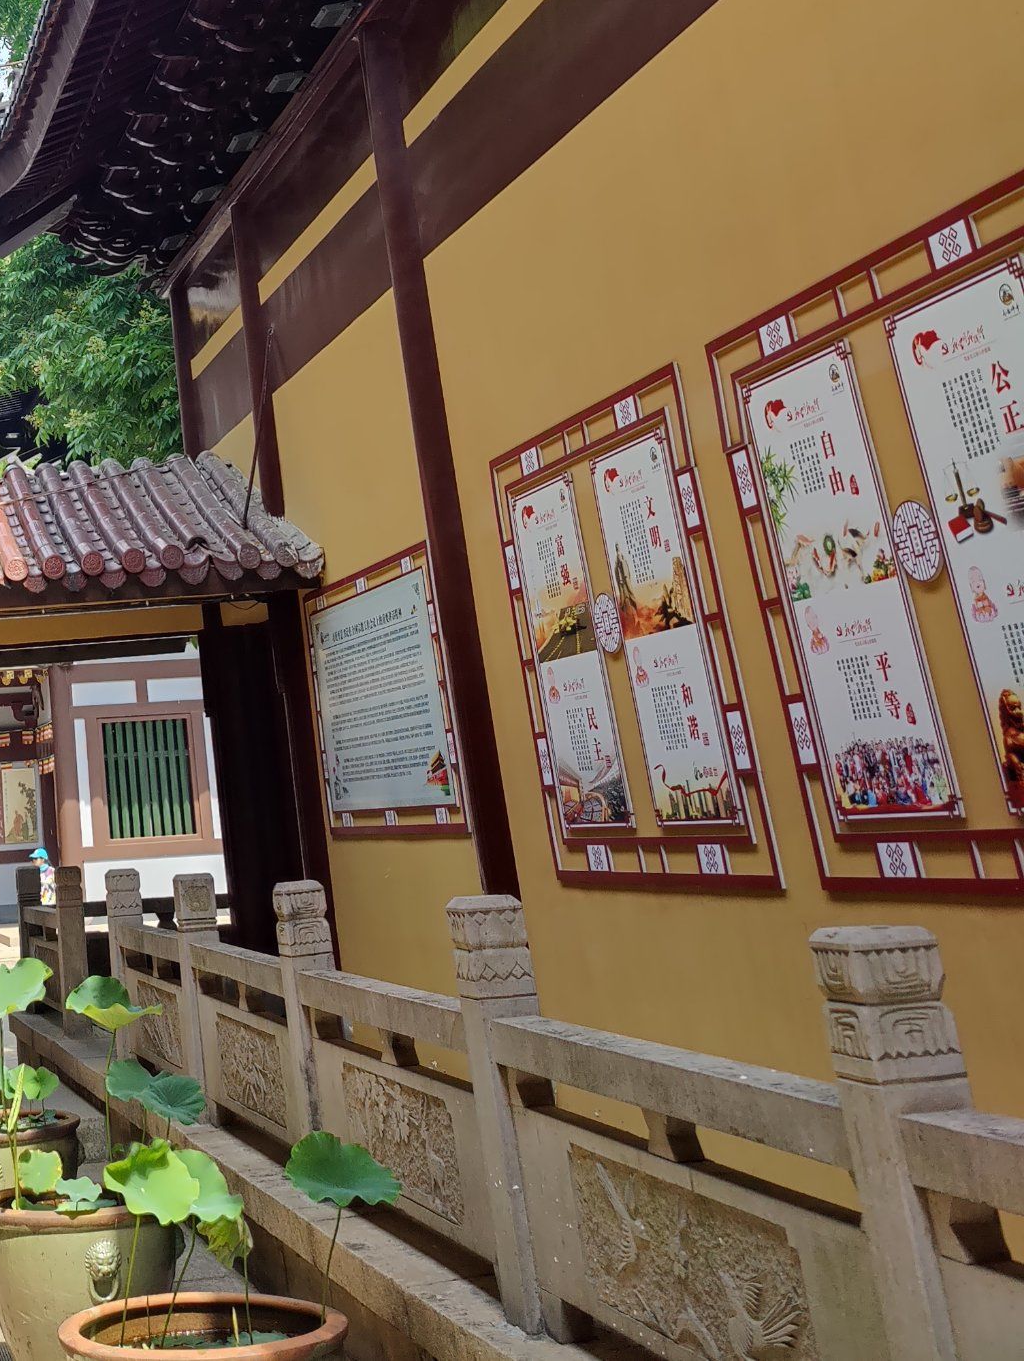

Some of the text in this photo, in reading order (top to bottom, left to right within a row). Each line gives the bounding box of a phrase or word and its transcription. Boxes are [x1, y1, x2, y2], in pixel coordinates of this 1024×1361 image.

[991, 360, 1024, 434] 公正
[820, 430, 845, 495] 自由
[643, 496, 662, 549] 文明
[555, 534, 571, 586] 富强
[681, 683, 700, 740] 和谐
[874, 651, 901, 720] 平等
[586, 707, 604, 761] 民主
